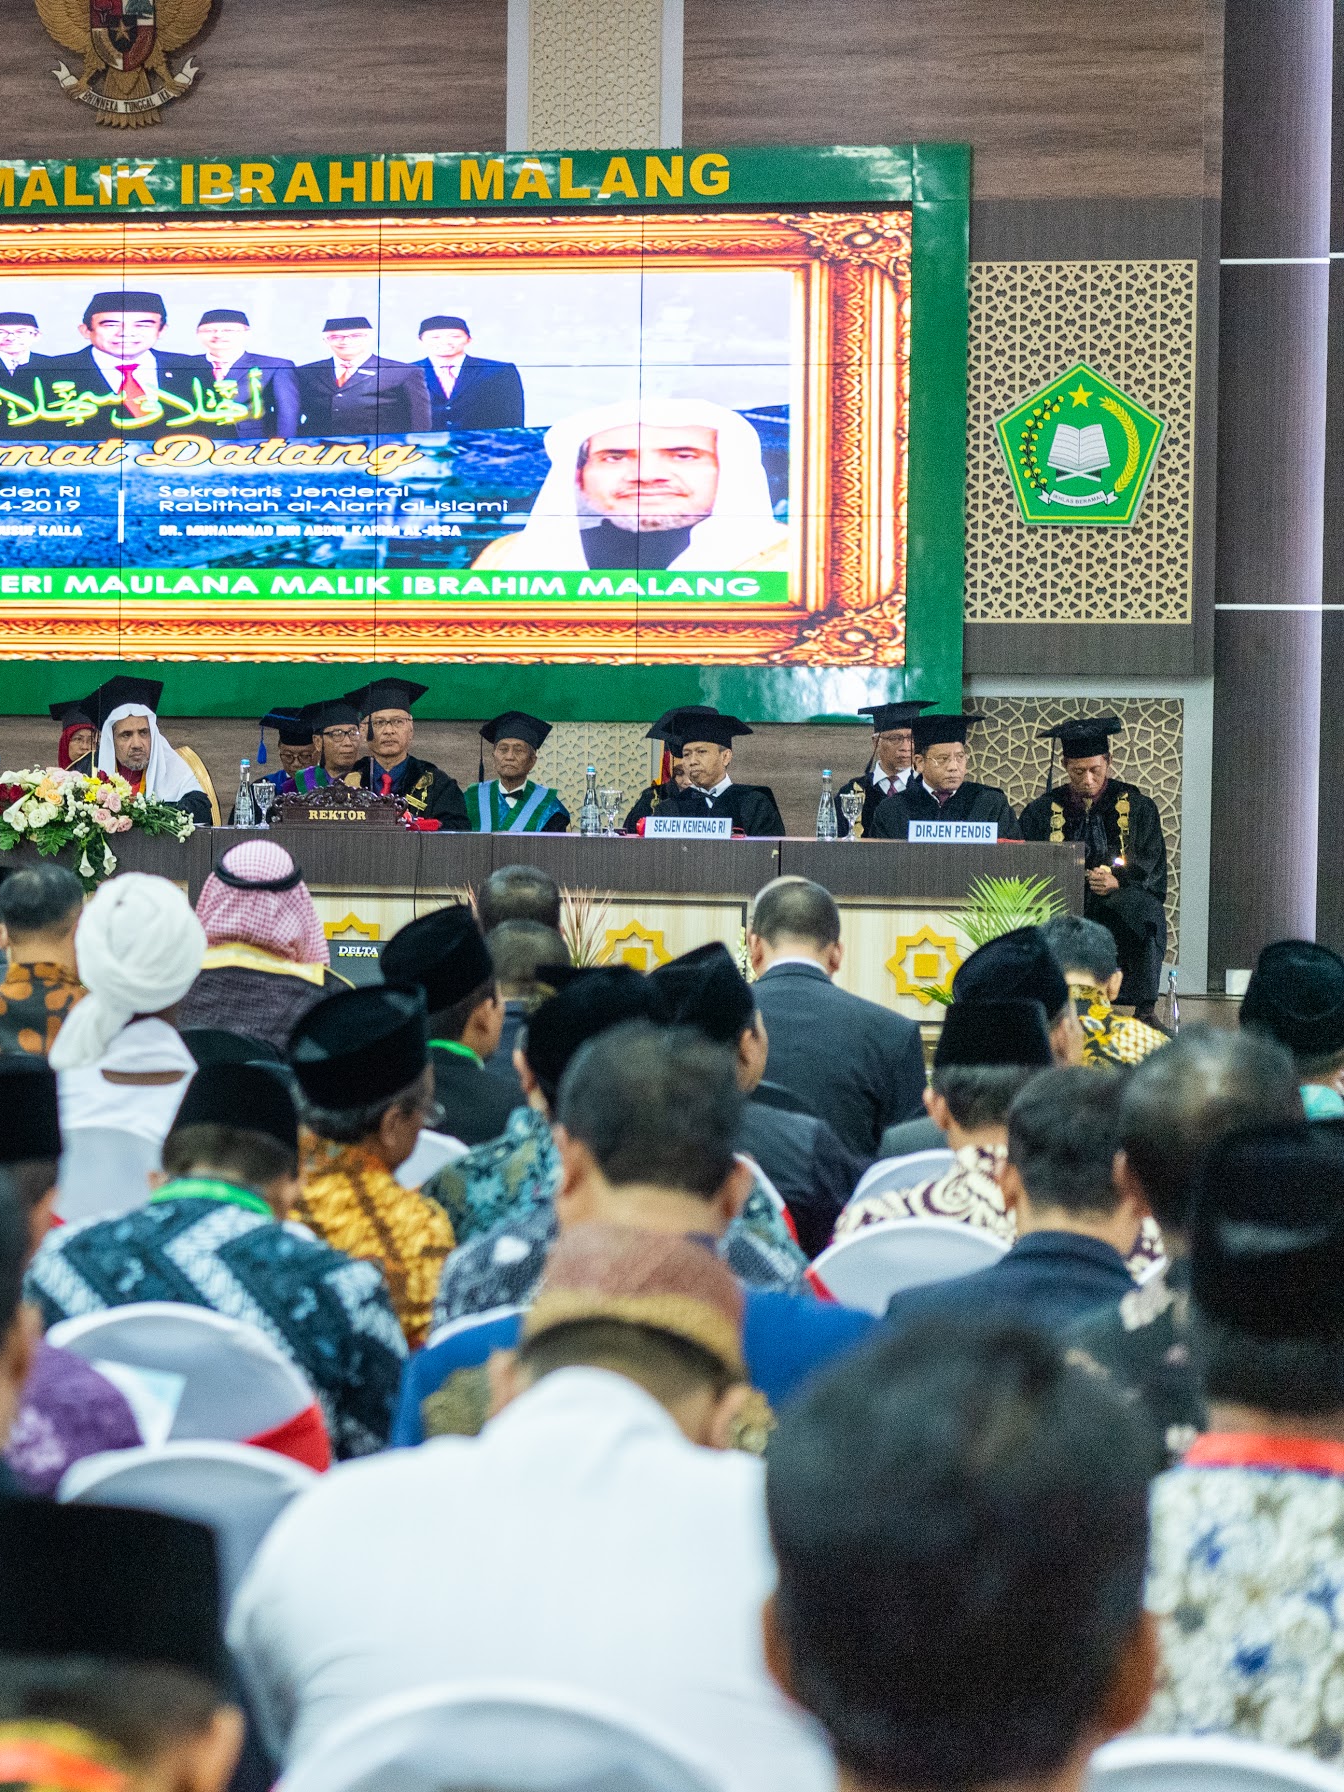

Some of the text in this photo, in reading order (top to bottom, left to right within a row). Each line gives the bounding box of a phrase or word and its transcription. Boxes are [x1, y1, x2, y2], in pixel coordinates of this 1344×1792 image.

[82, 90, 172, 112] BHINNEKA TUNGGAL IKA
[181, 160, 433, 204] IBRAHIM
[460, 153, 730, 200] MALANG
[136, 435, 423, 476] Datang
[60, 486, 80, 498] RI
[159, 485, 408, 498] Sekretaris Jenderal
[160, 499, 508, 513] Rabithah al-Alam al-Islami
[38, 525, 82, 536] KALLA
[186, 525, 274, 536] MUHAMMAD
[276, 525, 300, 536] BIN
[304, 525, 348, 536] ABDUL
[64, 576, 259, 594] MAULANA
[271, 576, 391, 594] MALIK
[403, 577, 566, 595] IBRAHIM
[578, 577, 761, 596] MALANG
[308, 810, 366, 820] REKTOR
[654, 820, 726, 833] SEKJEN KEMENAG RI
[916, 824, 991, 838] DIRJEN PENDIS
[338, 946, 378, 954] DELTA
